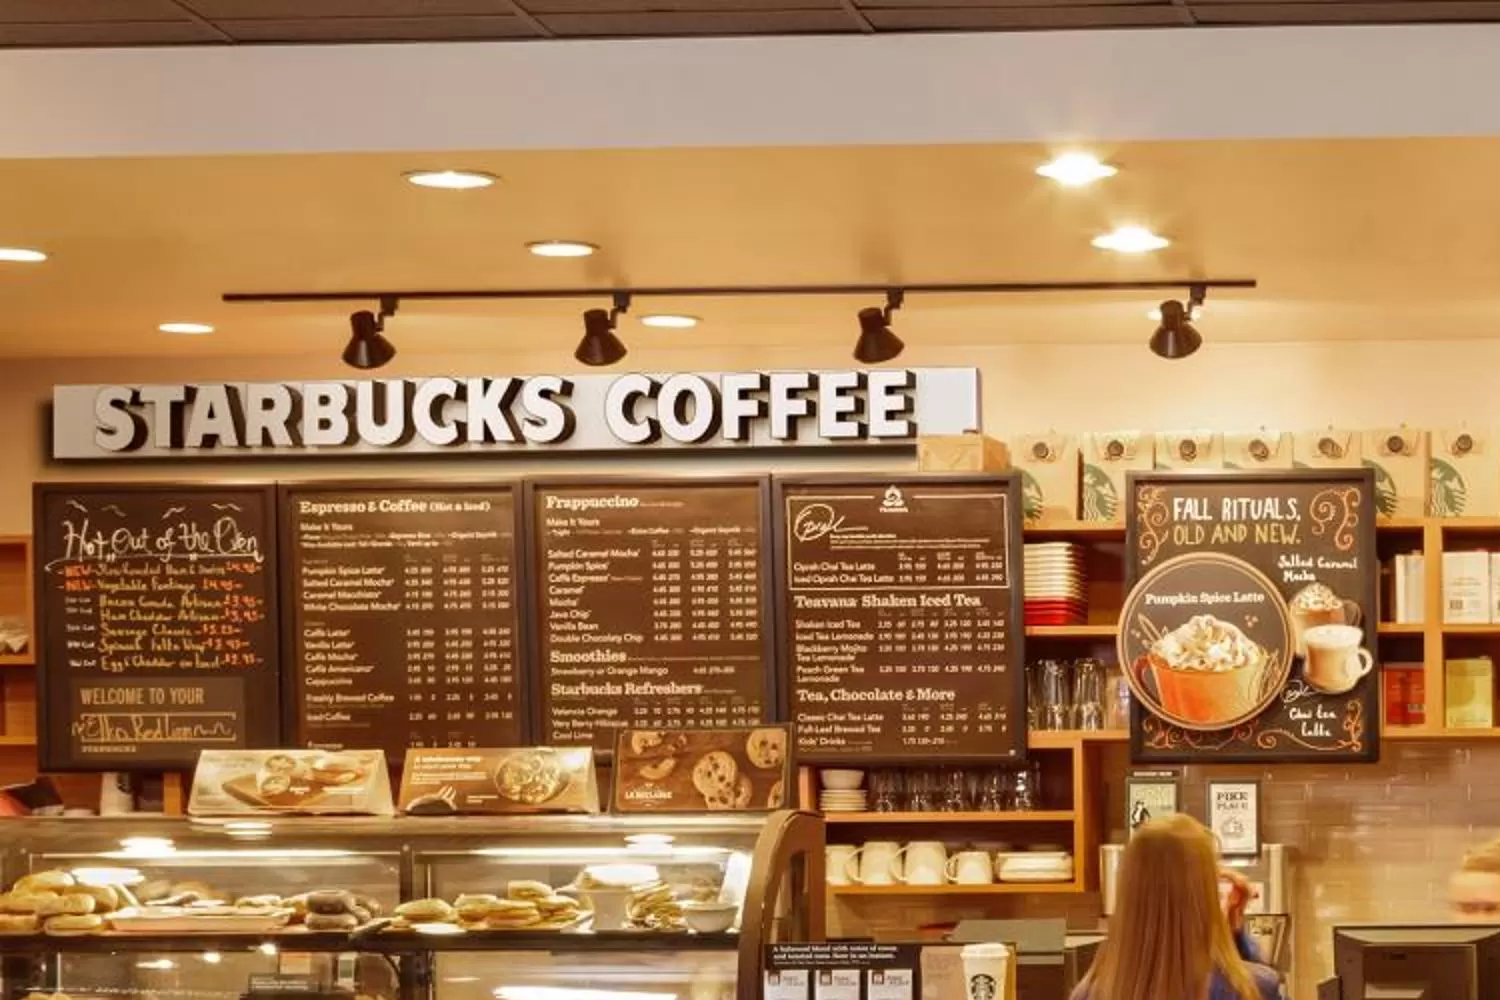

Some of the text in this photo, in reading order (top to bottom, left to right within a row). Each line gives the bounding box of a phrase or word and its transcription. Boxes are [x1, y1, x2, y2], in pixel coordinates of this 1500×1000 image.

[94, 371, 916, 451] STARBUCKS COFFEE
[300, 501, 366, 515] Espresso
[368, 501, 376, 512] &
[379, 499, 427, 513] Coffee
[546, 496, 639, 511] Frappuccino
[1173, 497, 1213, 521] FALL
[62, 519, 108, 561] Hot
[156, 527, 176, 562] of
[179, 522, 214, 552] the
[1173, 524, 1301, 545] OLD AND NEW.
[549, 562, 584, 572] Pumpkin
[1278, 555, 1358, 569] Salted Caramel
[1283, 570, 1316, 582] Mocha
[794, 593, 982, 608] Teavana Shaken Iced Tea
[1145, 591, 1265, 605] Pumpkin Spice Latte
[550, 650, 627, 663] Smoothies
[551, 681, 622, 696] Starbucks
[797, 688, 955, 703] Tea, Chocolate & More
[80, 688, 204, 705] WELCOME TO YOUR
[1289, 706, 1313, 720] Chai
[1216, 792, 1248, 800] PIKE
